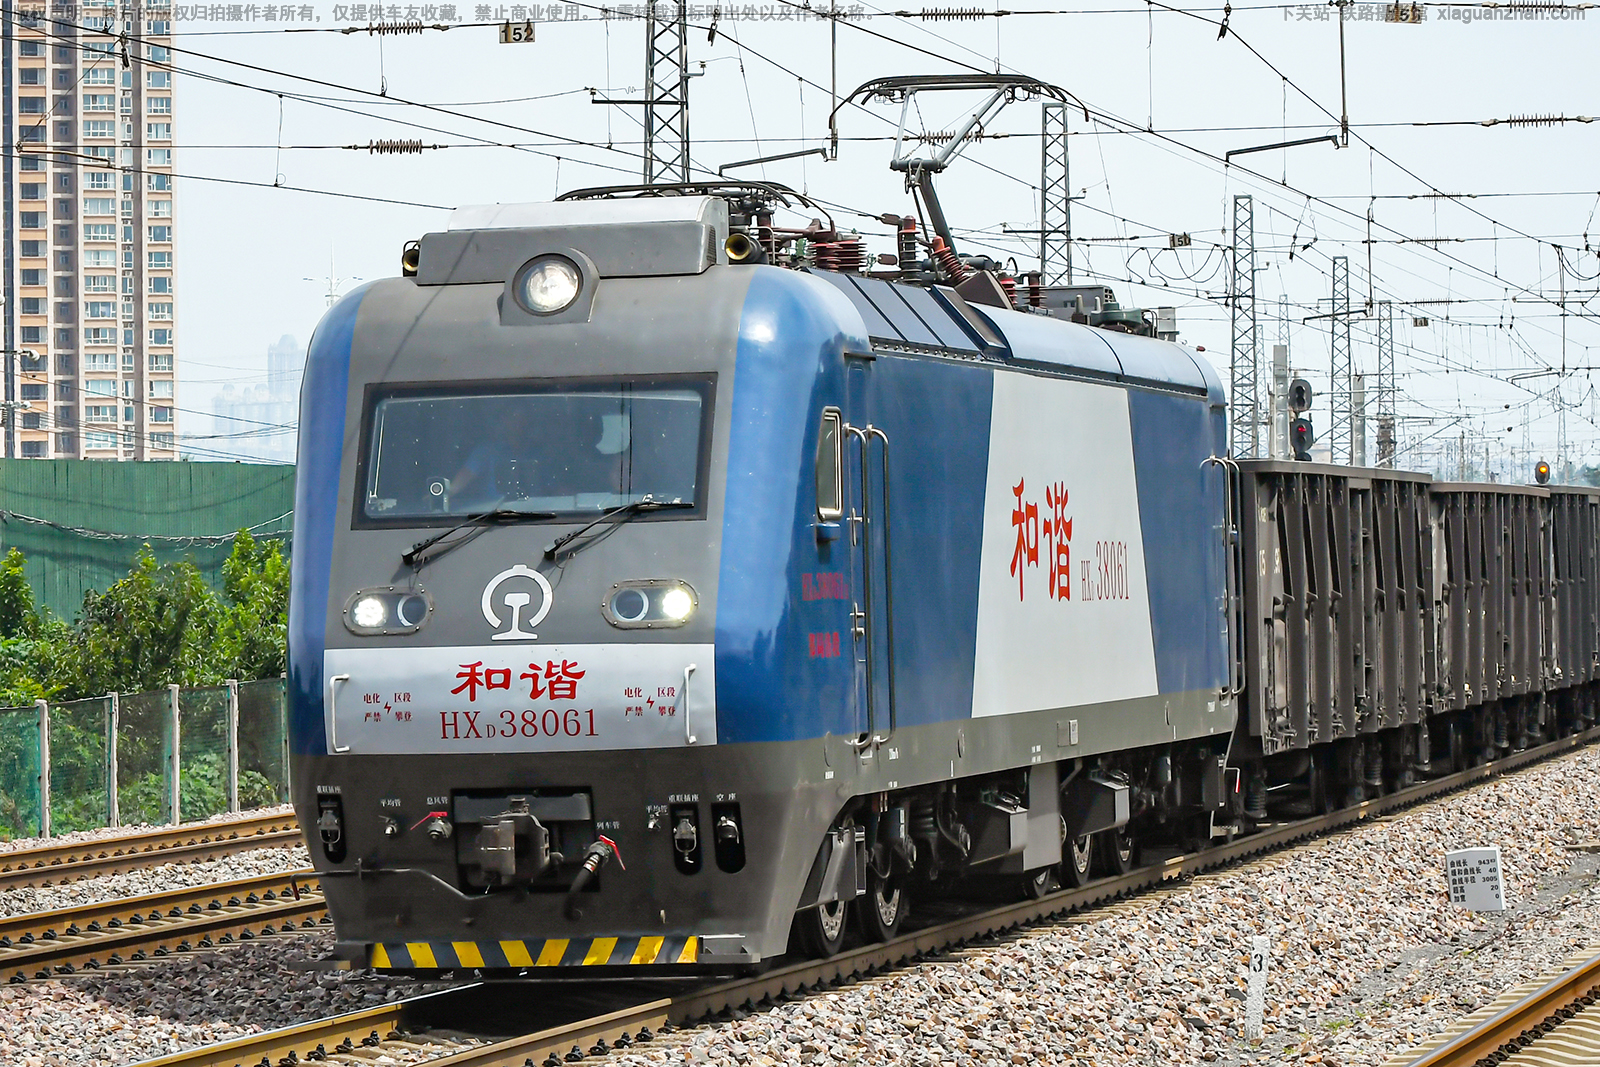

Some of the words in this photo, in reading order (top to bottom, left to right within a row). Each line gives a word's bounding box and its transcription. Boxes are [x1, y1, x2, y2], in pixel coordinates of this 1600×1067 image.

[501, 27, 534, 42] 152
[1010, 476, 1073, 602] 和谐
[450, 659, 586, 702] 和谐
[363, 693, 381, 704] 电化
[394, 692, 412, 703] 区段
[624, 687, 643, 698] 电化
[657, 686, 675, 697] 区段
[364, 711, 381, 723] 严禁
[625, 705, 643, 717] 严禁
[439, 708, 599, 739] HXD38061
[1450, 859, 1467, 868] 曲线长
[1452, 876, 1476, 885] 曲线半径
[1253, 953, 1264, 973] 3
